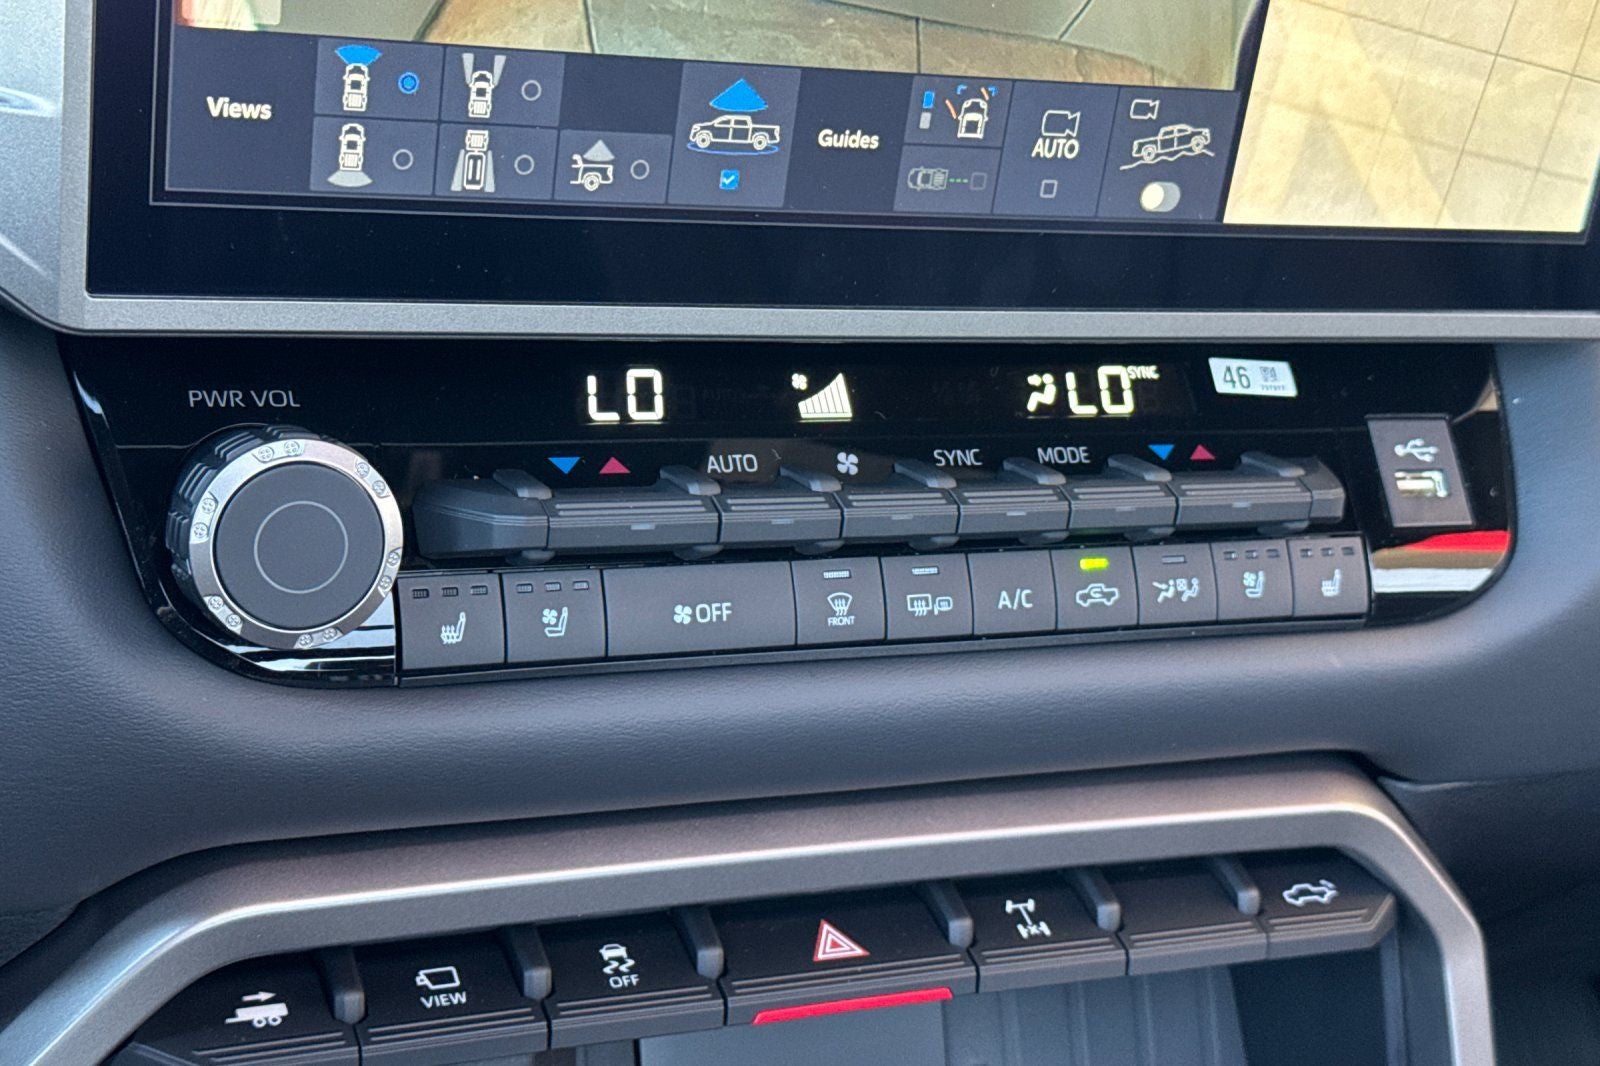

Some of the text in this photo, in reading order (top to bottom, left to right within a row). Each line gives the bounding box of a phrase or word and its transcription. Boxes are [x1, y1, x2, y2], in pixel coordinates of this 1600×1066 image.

[206, 95, 272, 121] Views
[817, 128, 880, 151] Guides
[1031, 138, 1080, 160] AUTO
[1127, 365, 1160, 380] SYNC
[1223, 365, 1251, 389] 46
[188, 389, 301, 408] PWR VOL
[586, 368, 664, 421] LO
[1065, 365, 1135, 415] LO
[706, 453, 759, 475] AUTO
[933, 448, 983, 468] SYNC
[1037, 446, 1091, 465] MODE
[998, 589, 1033, 611] A/C
[696, 602, 733, 624] OFF
[827, 614, 856, 627] FRONT
[608, 974, 641, 989] OFF
[420, 991, 468, 1009] VIEW
